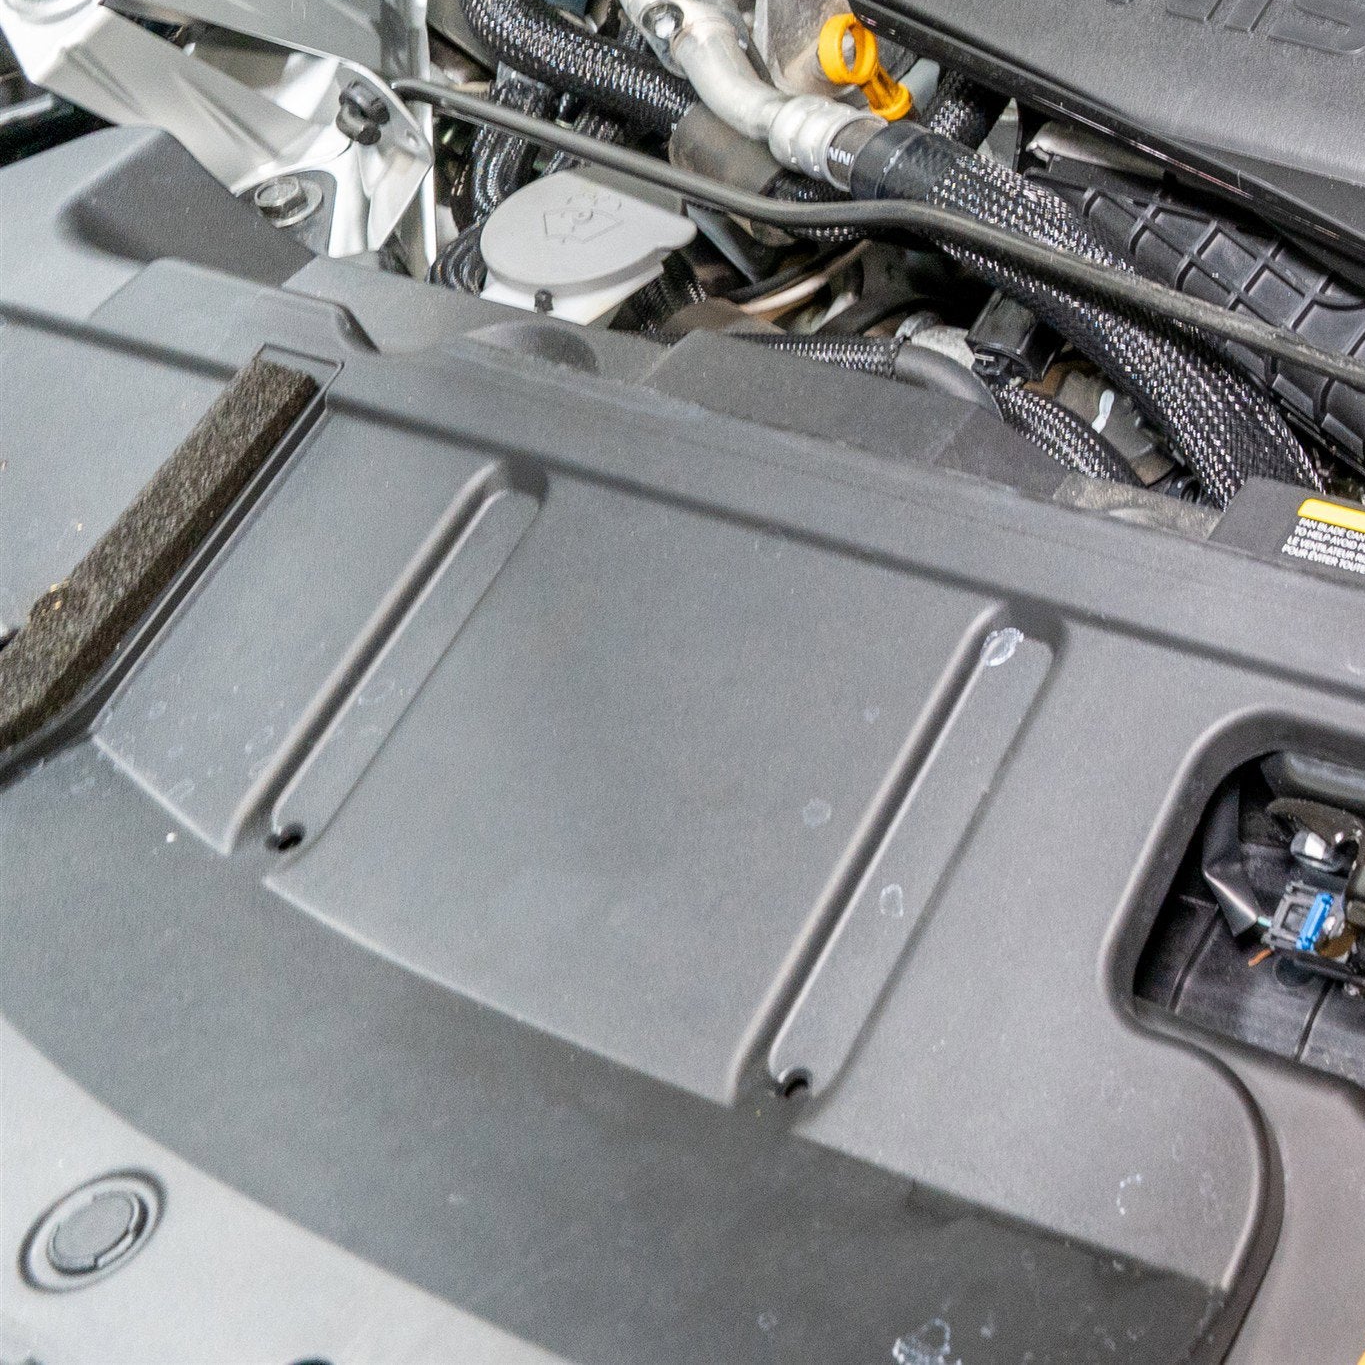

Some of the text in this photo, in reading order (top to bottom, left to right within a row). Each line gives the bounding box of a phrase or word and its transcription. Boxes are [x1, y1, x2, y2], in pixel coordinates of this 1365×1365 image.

[1295, 525, 1307, 537] TO
[1307, 529, 1330, 542] HELP
[1330, 534, 1357, 550] AVOID
[1299, 517, 1317, 529] FAN
[1317, 521, 1346, 537] BLADE
[1346, 529, 1365, 541] CAN
[1282, 543, 1308, 559] POUR
[1308, 549, 1339, 567] ÉVITER
[1287, 535, 1300, 546] LE
[1300, 539, 1355, 561] VENTILATEUR
